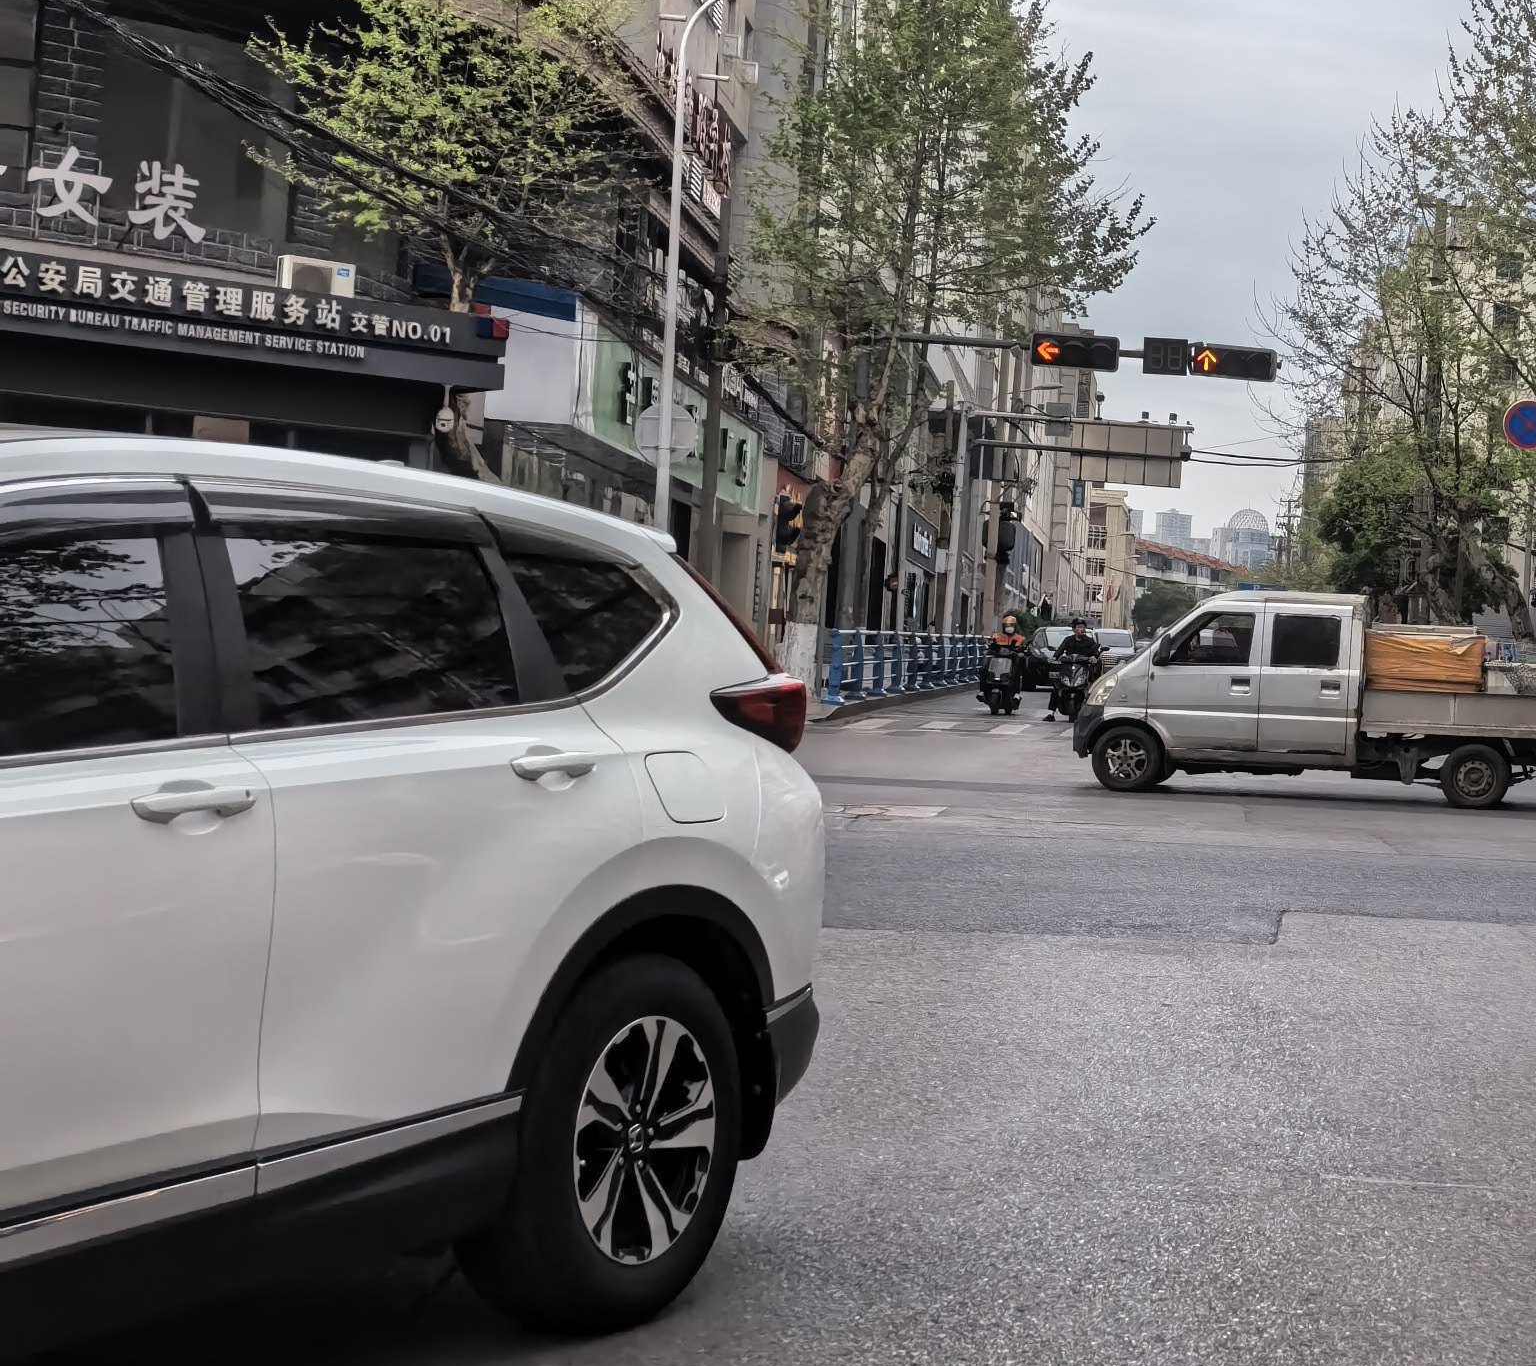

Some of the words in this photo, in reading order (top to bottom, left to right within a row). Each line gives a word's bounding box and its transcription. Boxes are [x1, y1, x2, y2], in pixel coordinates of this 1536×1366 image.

[28, 146, 206, 243] 女装
[1, 256, 342, 332] 公安局交通管理服务站
[3, 299, 65, 321] SECURITY
[70, 309, 119, 327] BUREAU
[124, 316, 173, 334] TRAFFIC
[178, 323, 260, 346] MANAGEMENT
[265, 333, 312, 352] SERVICE
[316, 340, 365, 359] STATION
